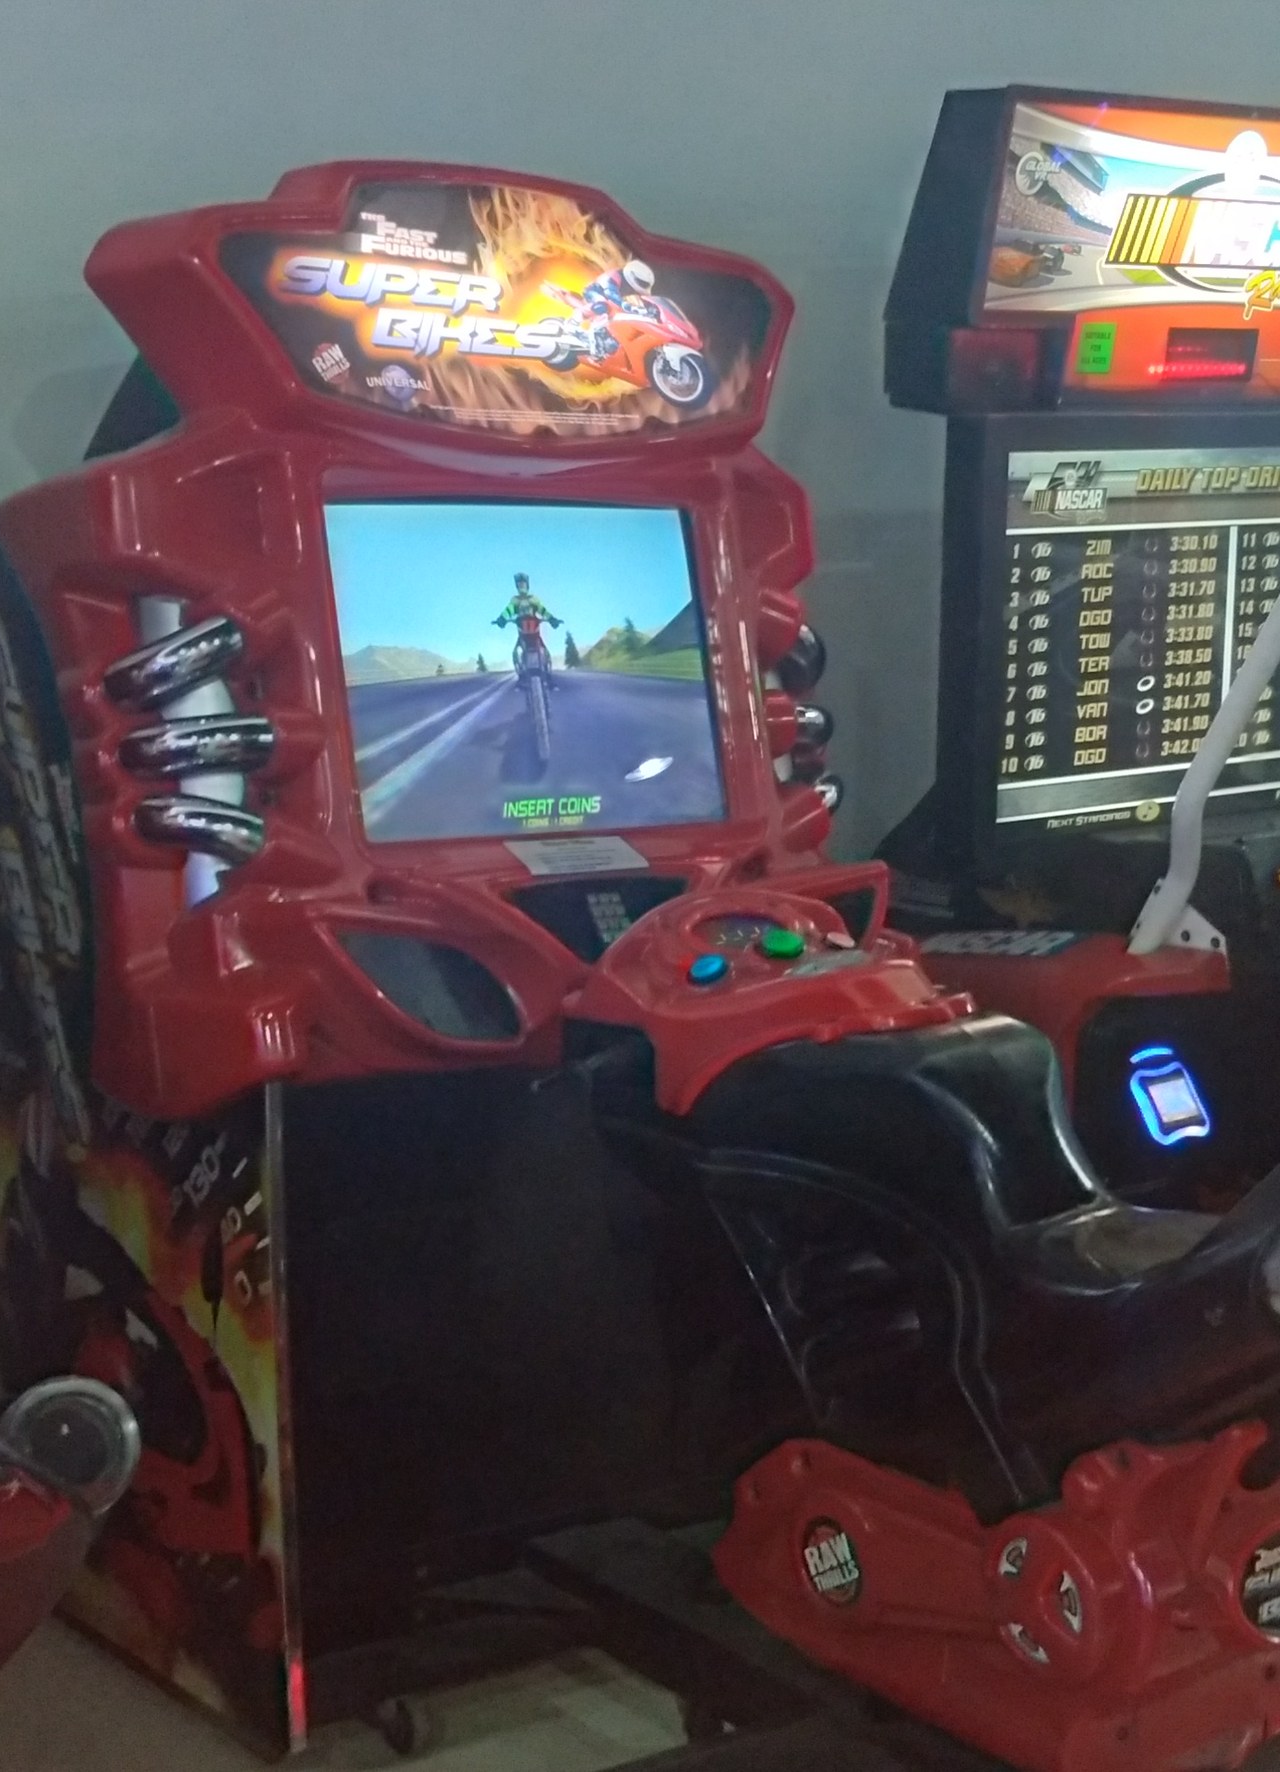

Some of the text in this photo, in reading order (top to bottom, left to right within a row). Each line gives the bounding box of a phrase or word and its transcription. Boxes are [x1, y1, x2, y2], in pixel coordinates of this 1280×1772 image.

[376, 220, 438, 245] FAST
[360, 232, 468, 266] FURIOUS
[280, 256, 504, 315] SUPER
[370, 308, 562, 359] BIKES
[311, 343, 348, 371] RAW
[365, 376, 432, 391] UNIVERSAL
[1136, 467, 1195, 493] DAILY
[1198, 466, 1243, 492] TOP
[1054, 489, 1104, 510] NASCAR
[1013, 543, 1020, 560] 1
[1085, 539, 1113, 556] ZIM
[1242, 533, 1257, 548] 11
[1010, 567, 1020, 584] 2
[1081, 562, 1114, 580] ROC
[1241, 556, 1257, 571] 12
[1240, 578, 1255, 593] 13
[1009, 591, 1020, 608] 3
[1081, 586, 1113, 603] TUP
[1239, 600, 1254, 616] 14
[1008, 615, 1019, 632] 4
[1238, 622, 1253, 638] 15
[1007, 639, 1018, 655] 5
[1079, 632, 1111, 650] TOW
[1007, 662, 1017, 679] 6
[1078, 656, 1110, 674] TER
[1006, 687, 1016, 703] 7
[1076, 679, 1110, 697] JON
[1005, 710, 1016, 727] 8
[1076, 702, 1108, 720] VAN
[1005, 734, 1015, 750] 9
[1234, 733, 1247, 748] 0
[1001, 757, 1018, 774] 10
[502, 795, 602, 819] INSERT COINS
[1075, 811, 1131, 826] STANDINGS
[803, 1532, 852, 1577] RAW
